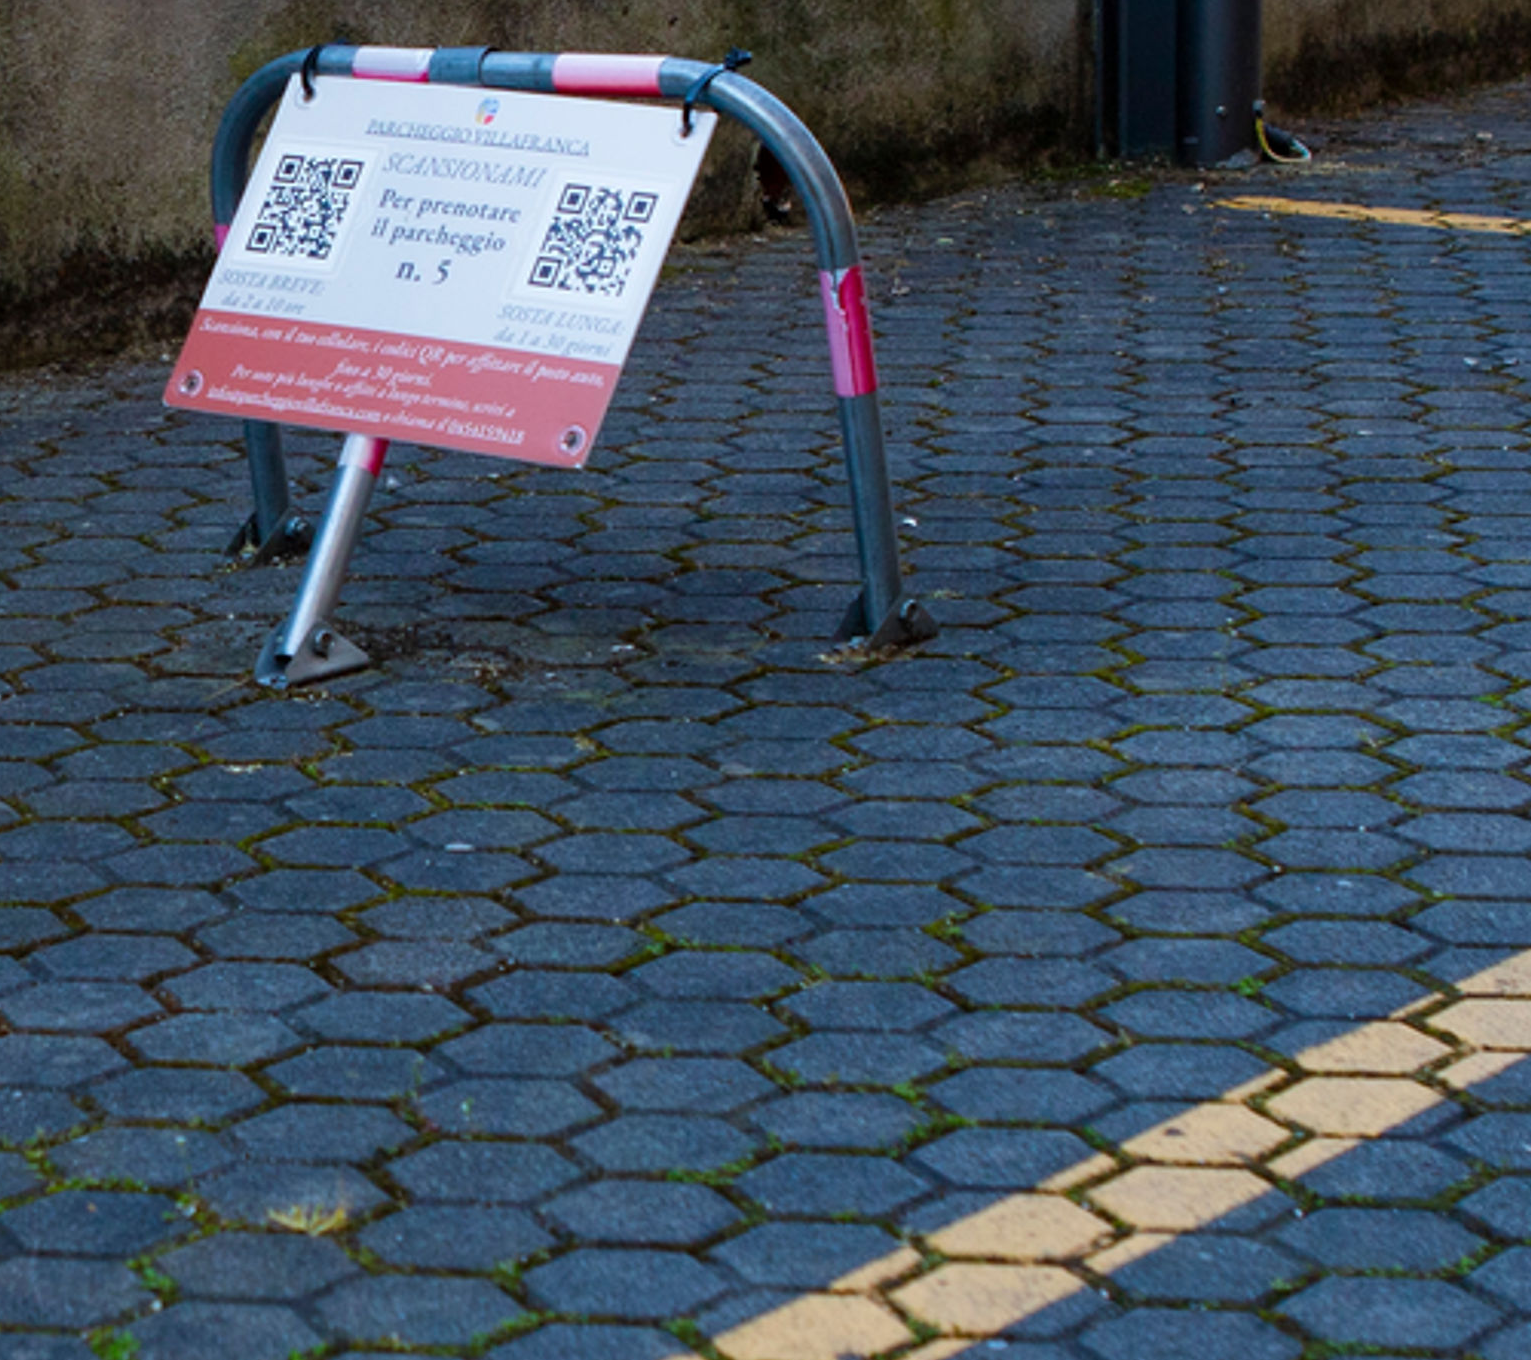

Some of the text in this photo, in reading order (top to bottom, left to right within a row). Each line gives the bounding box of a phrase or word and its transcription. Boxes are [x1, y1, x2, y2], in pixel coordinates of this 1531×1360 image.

[365, 119, 589, 156] PARCHEGGIO VILLAFRANCA
[382, 152, 547, 189] SCANSIONAMI
[379, 188, 521, 223] Per prenotare
[371, 217, 506, 256] il parcheggio
[395, 259, 452, 285] n. 5
